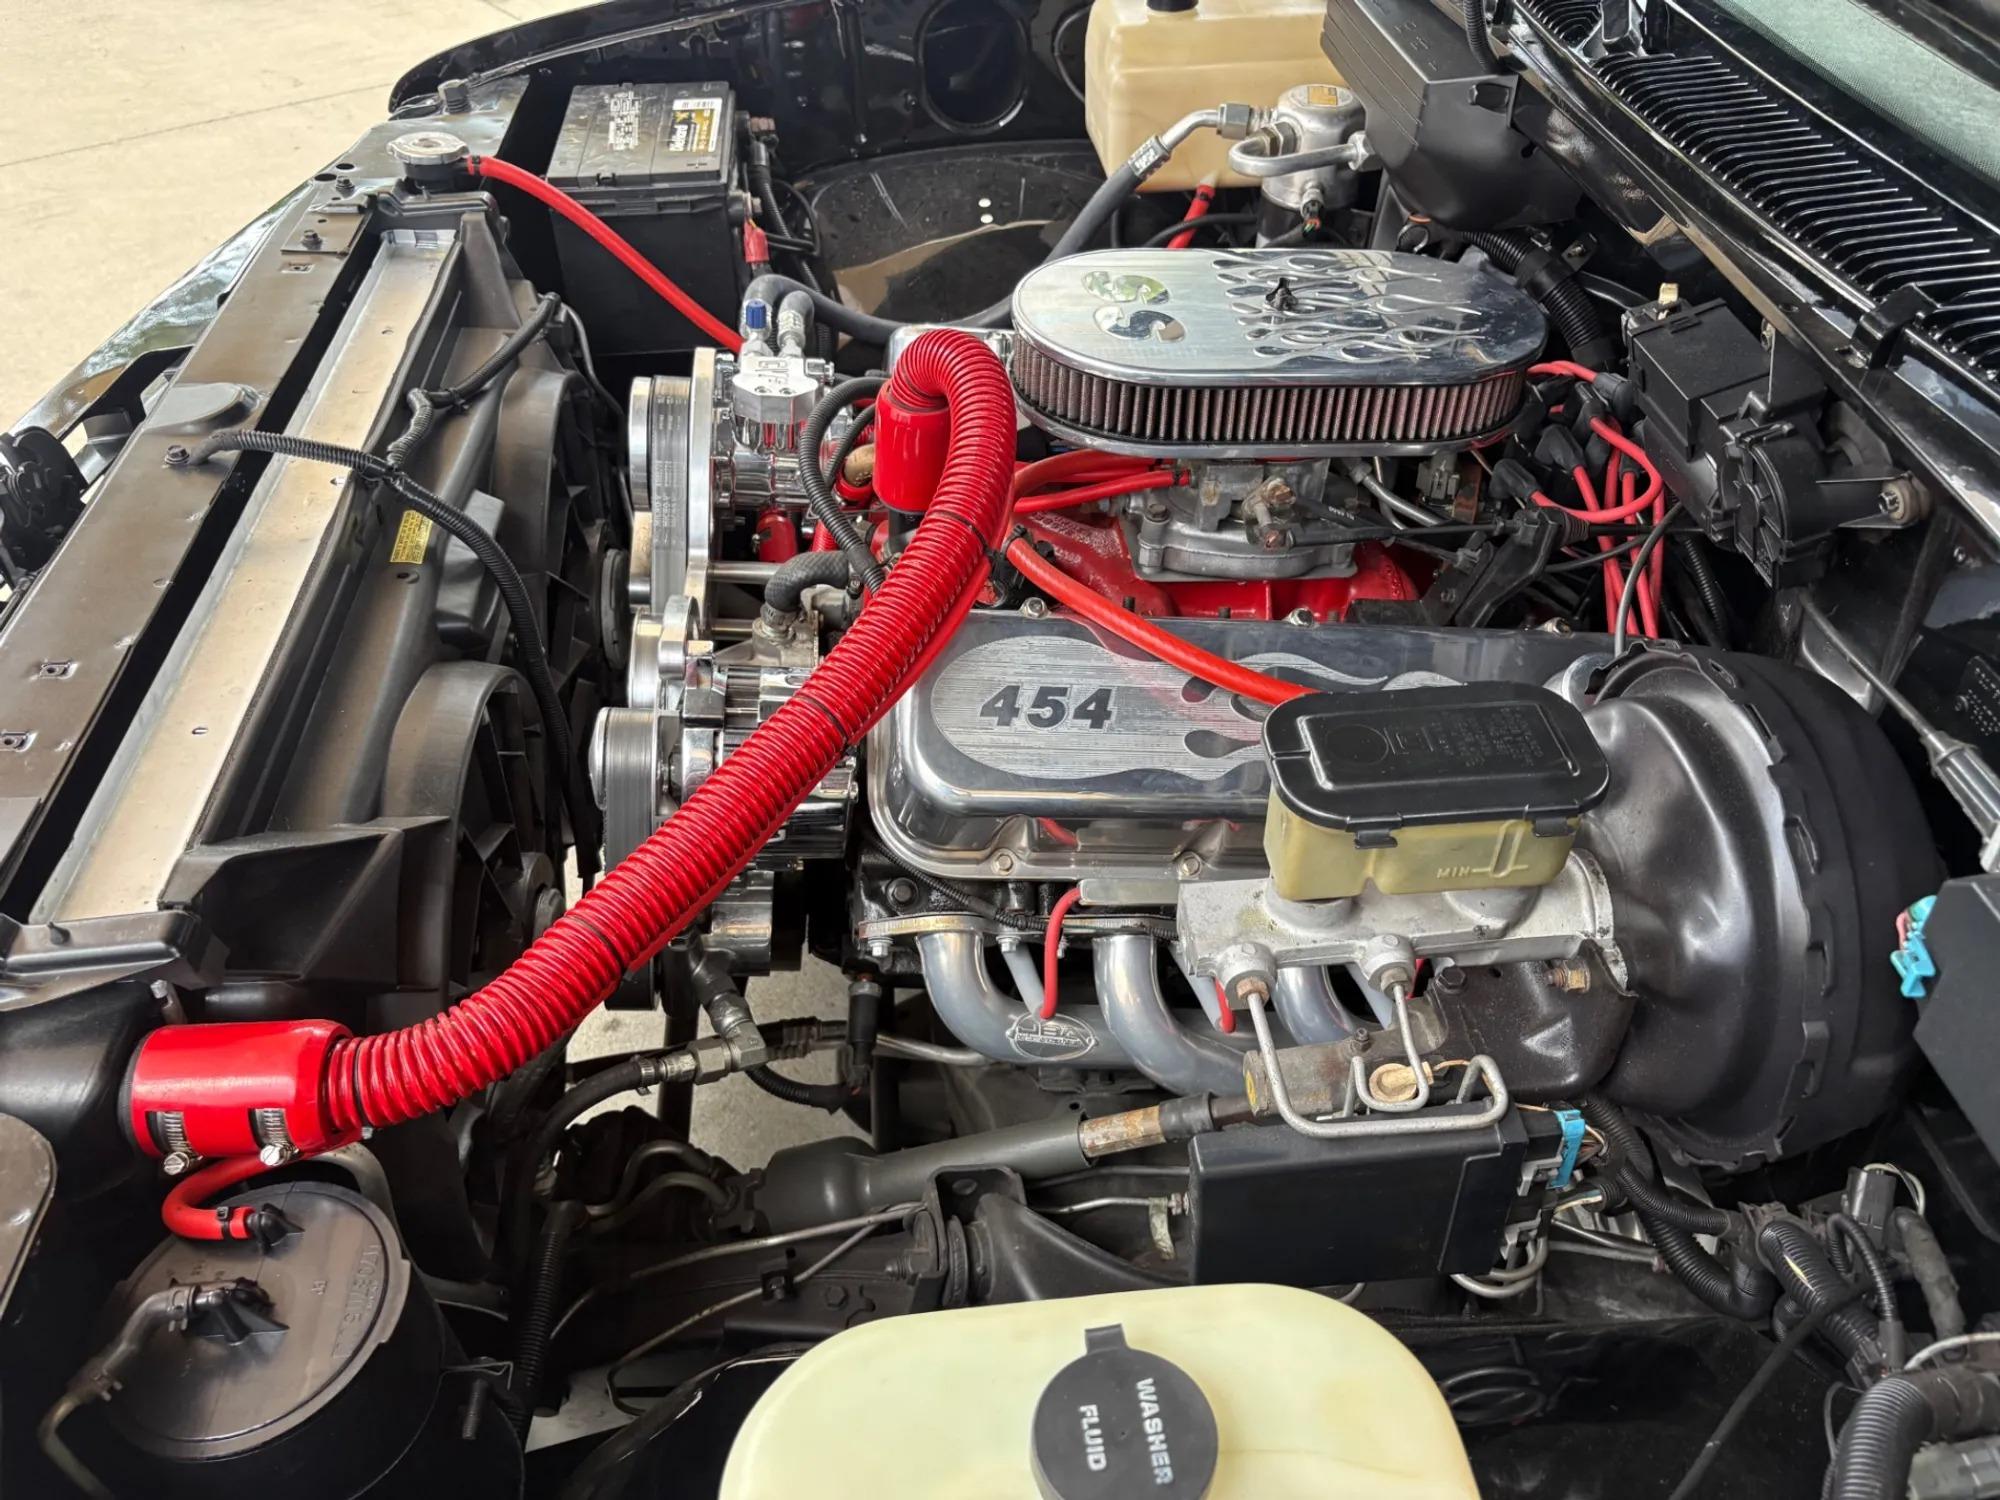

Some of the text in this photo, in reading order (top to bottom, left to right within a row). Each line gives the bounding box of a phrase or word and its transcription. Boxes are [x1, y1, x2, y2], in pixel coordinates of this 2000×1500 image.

[980, 685, 1113, 729] 454
[1437, 865, 1471, 879] MIN
[1079, 1404, 1107, 1472] FLUID
[1137, 1378, 1174, 1485] WASHER
